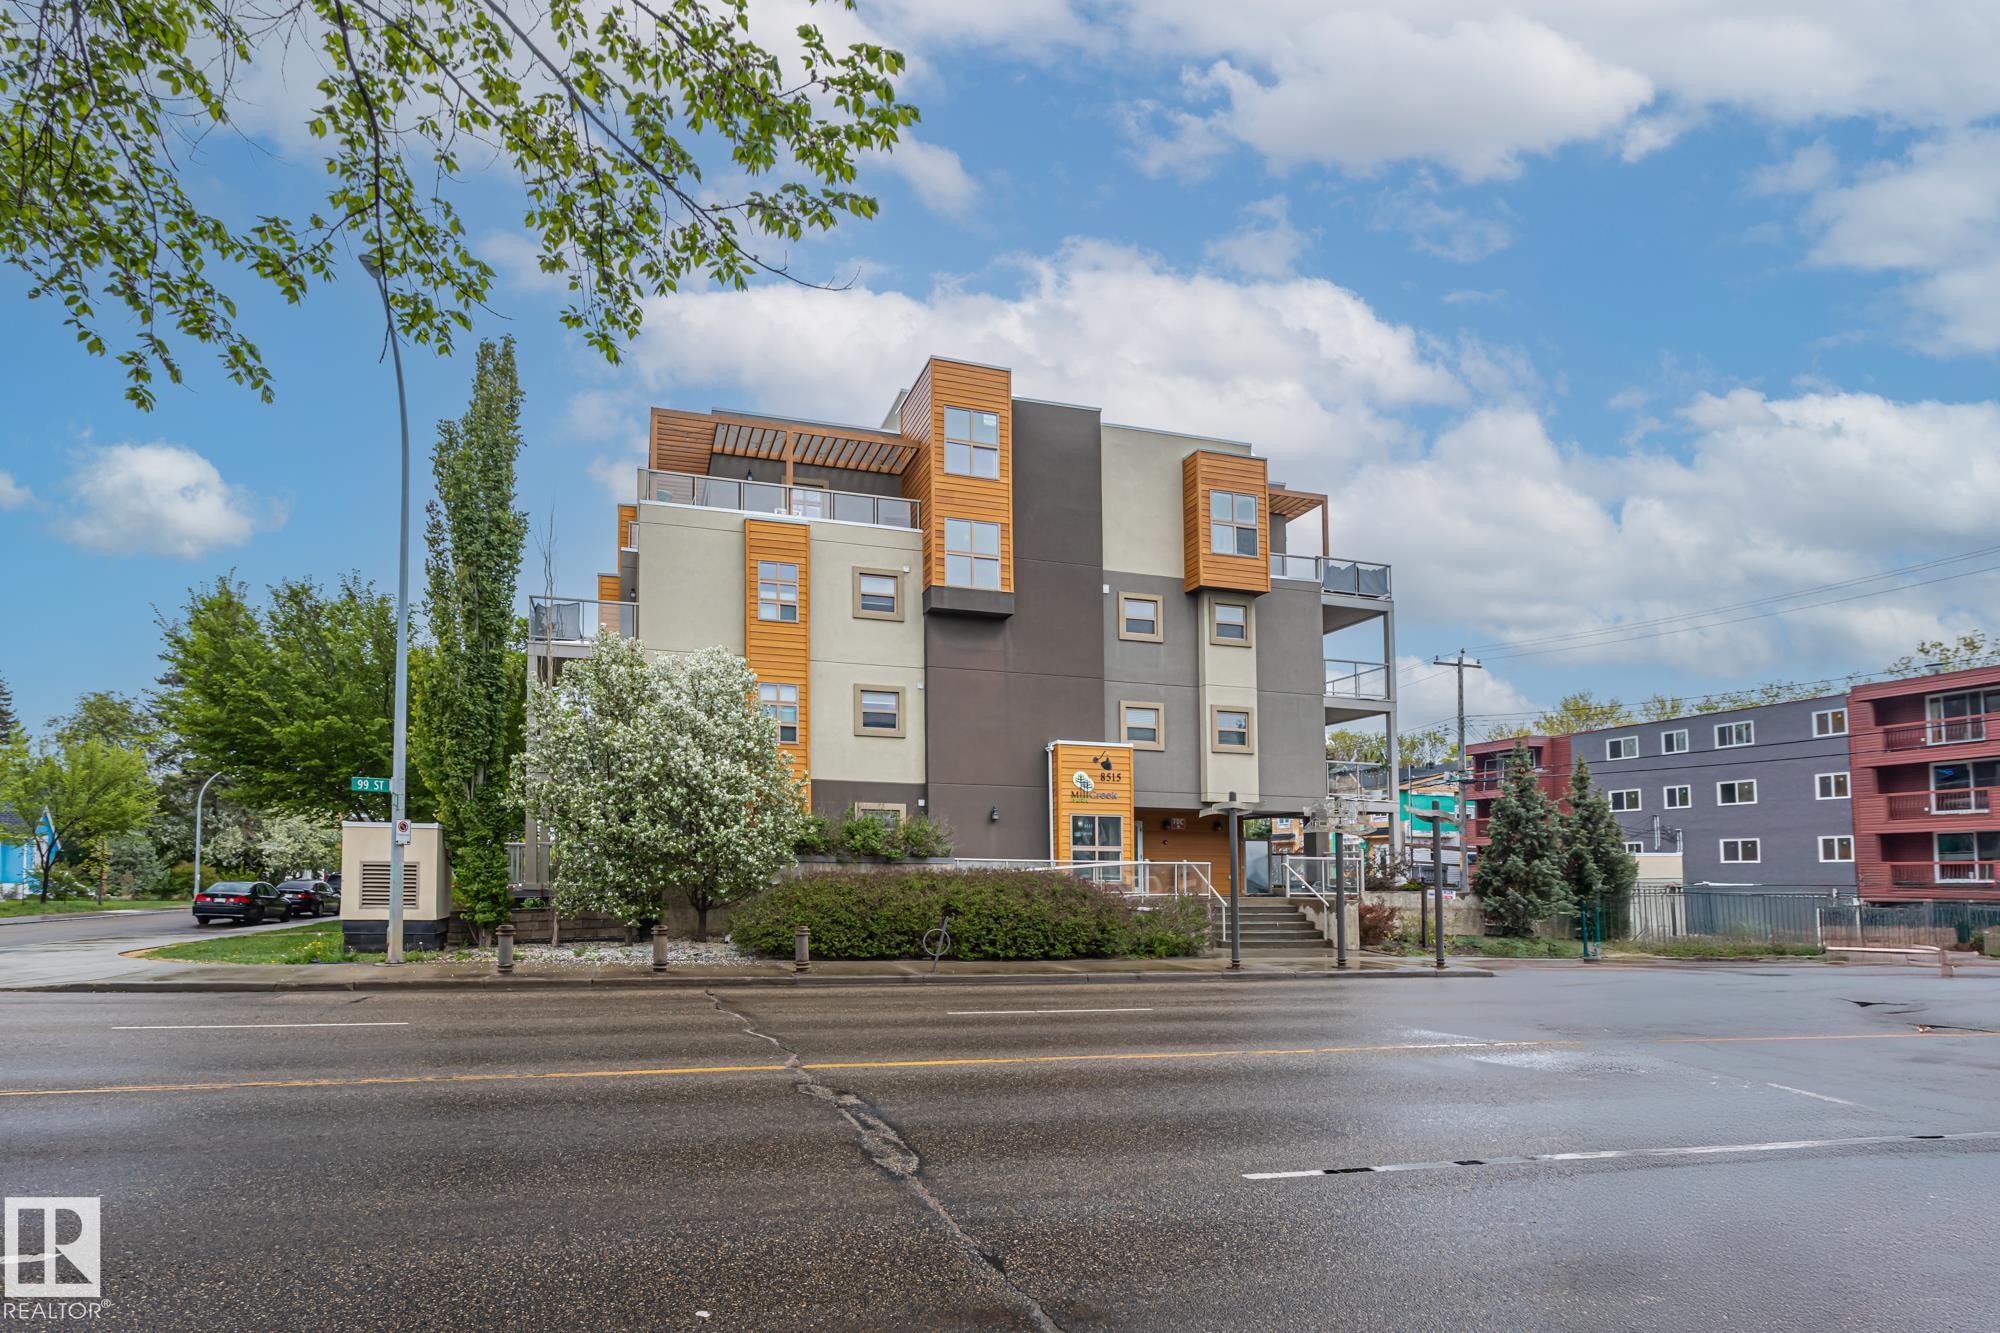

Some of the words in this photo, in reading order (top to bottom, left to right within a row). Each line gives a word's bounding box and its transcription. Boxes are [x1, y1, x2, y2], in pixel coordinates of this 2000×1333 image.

[1100, 772, 1122, 782] 8515
[357, 779, 369, 790] 99
[373, 780, 385, 790] ST
